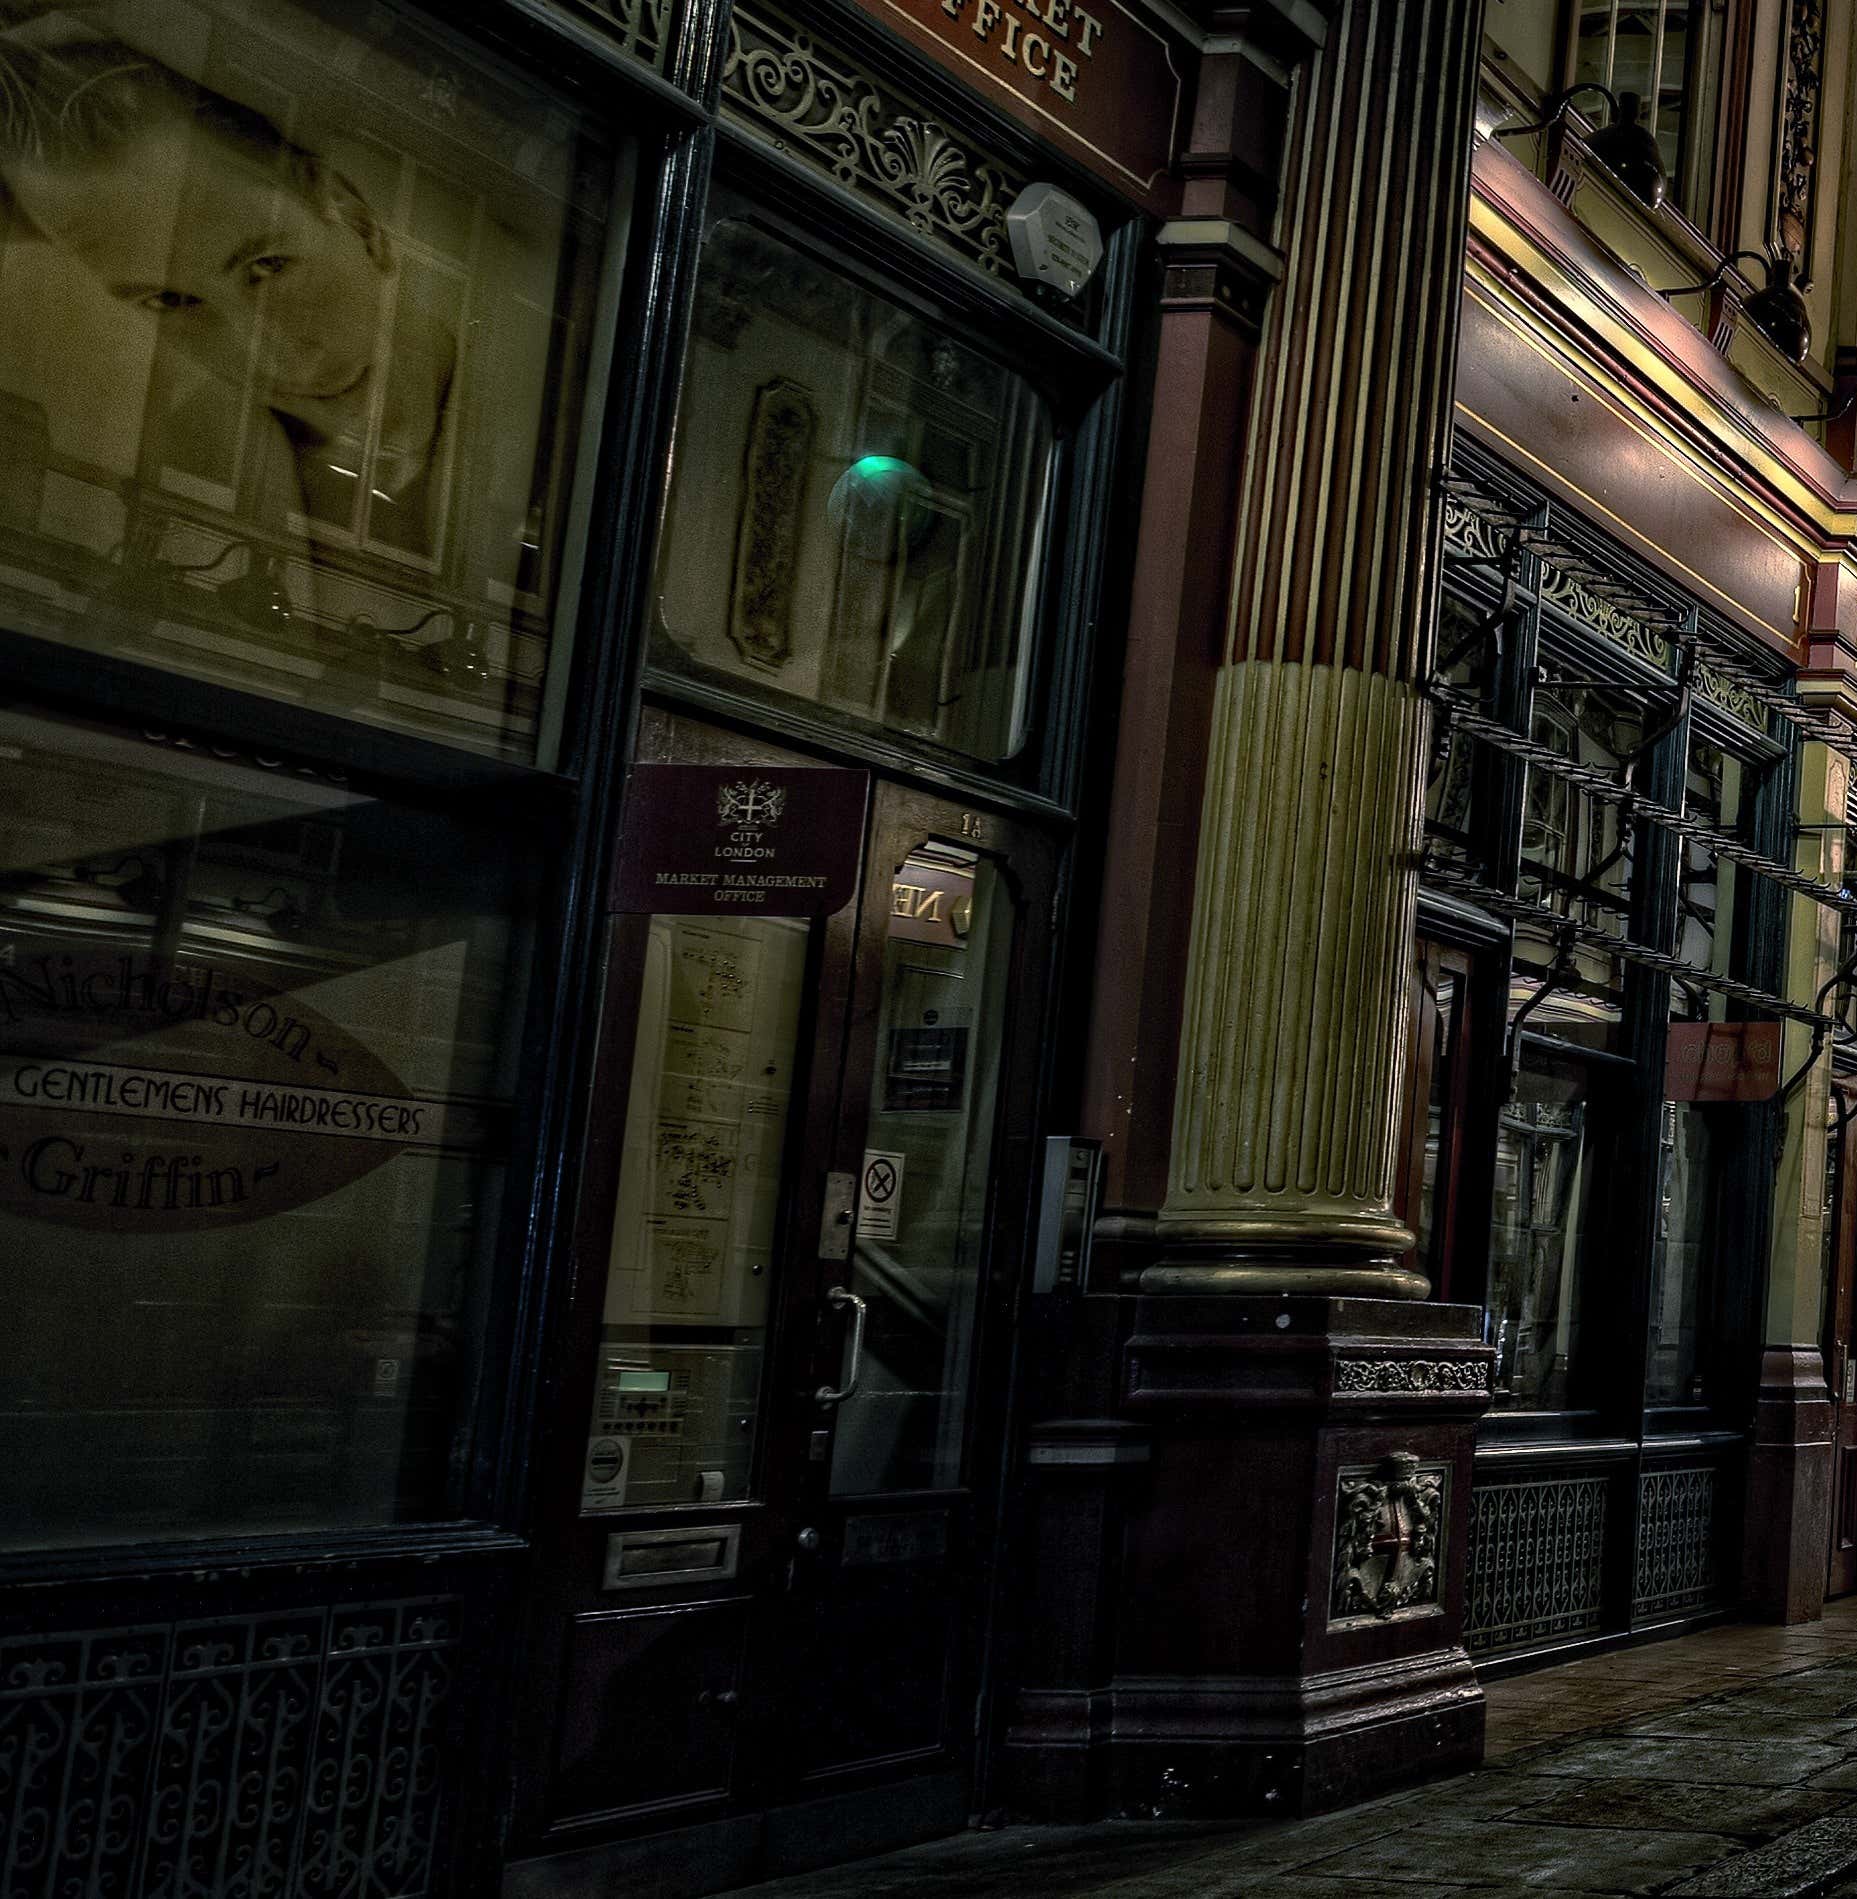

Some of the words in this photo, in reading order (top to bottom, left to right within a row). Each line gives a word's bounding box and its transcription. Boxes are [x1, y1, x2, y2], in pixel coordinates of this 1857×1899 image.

[730, 832, 763, 843] CITY
[714, 847, 775, 858] LONDON
[655, 873, 719, 887] MARKET
[723, 874, 828, 888] MANAGEMENT
[713, 890, 766, 902] OFFICE
[14, 1064, 229, 1117] GENTLEMENS
[239, 1089, 425, 1136] HAIRDRESSERS
[22, 1136, 248, 1210] Griffin
